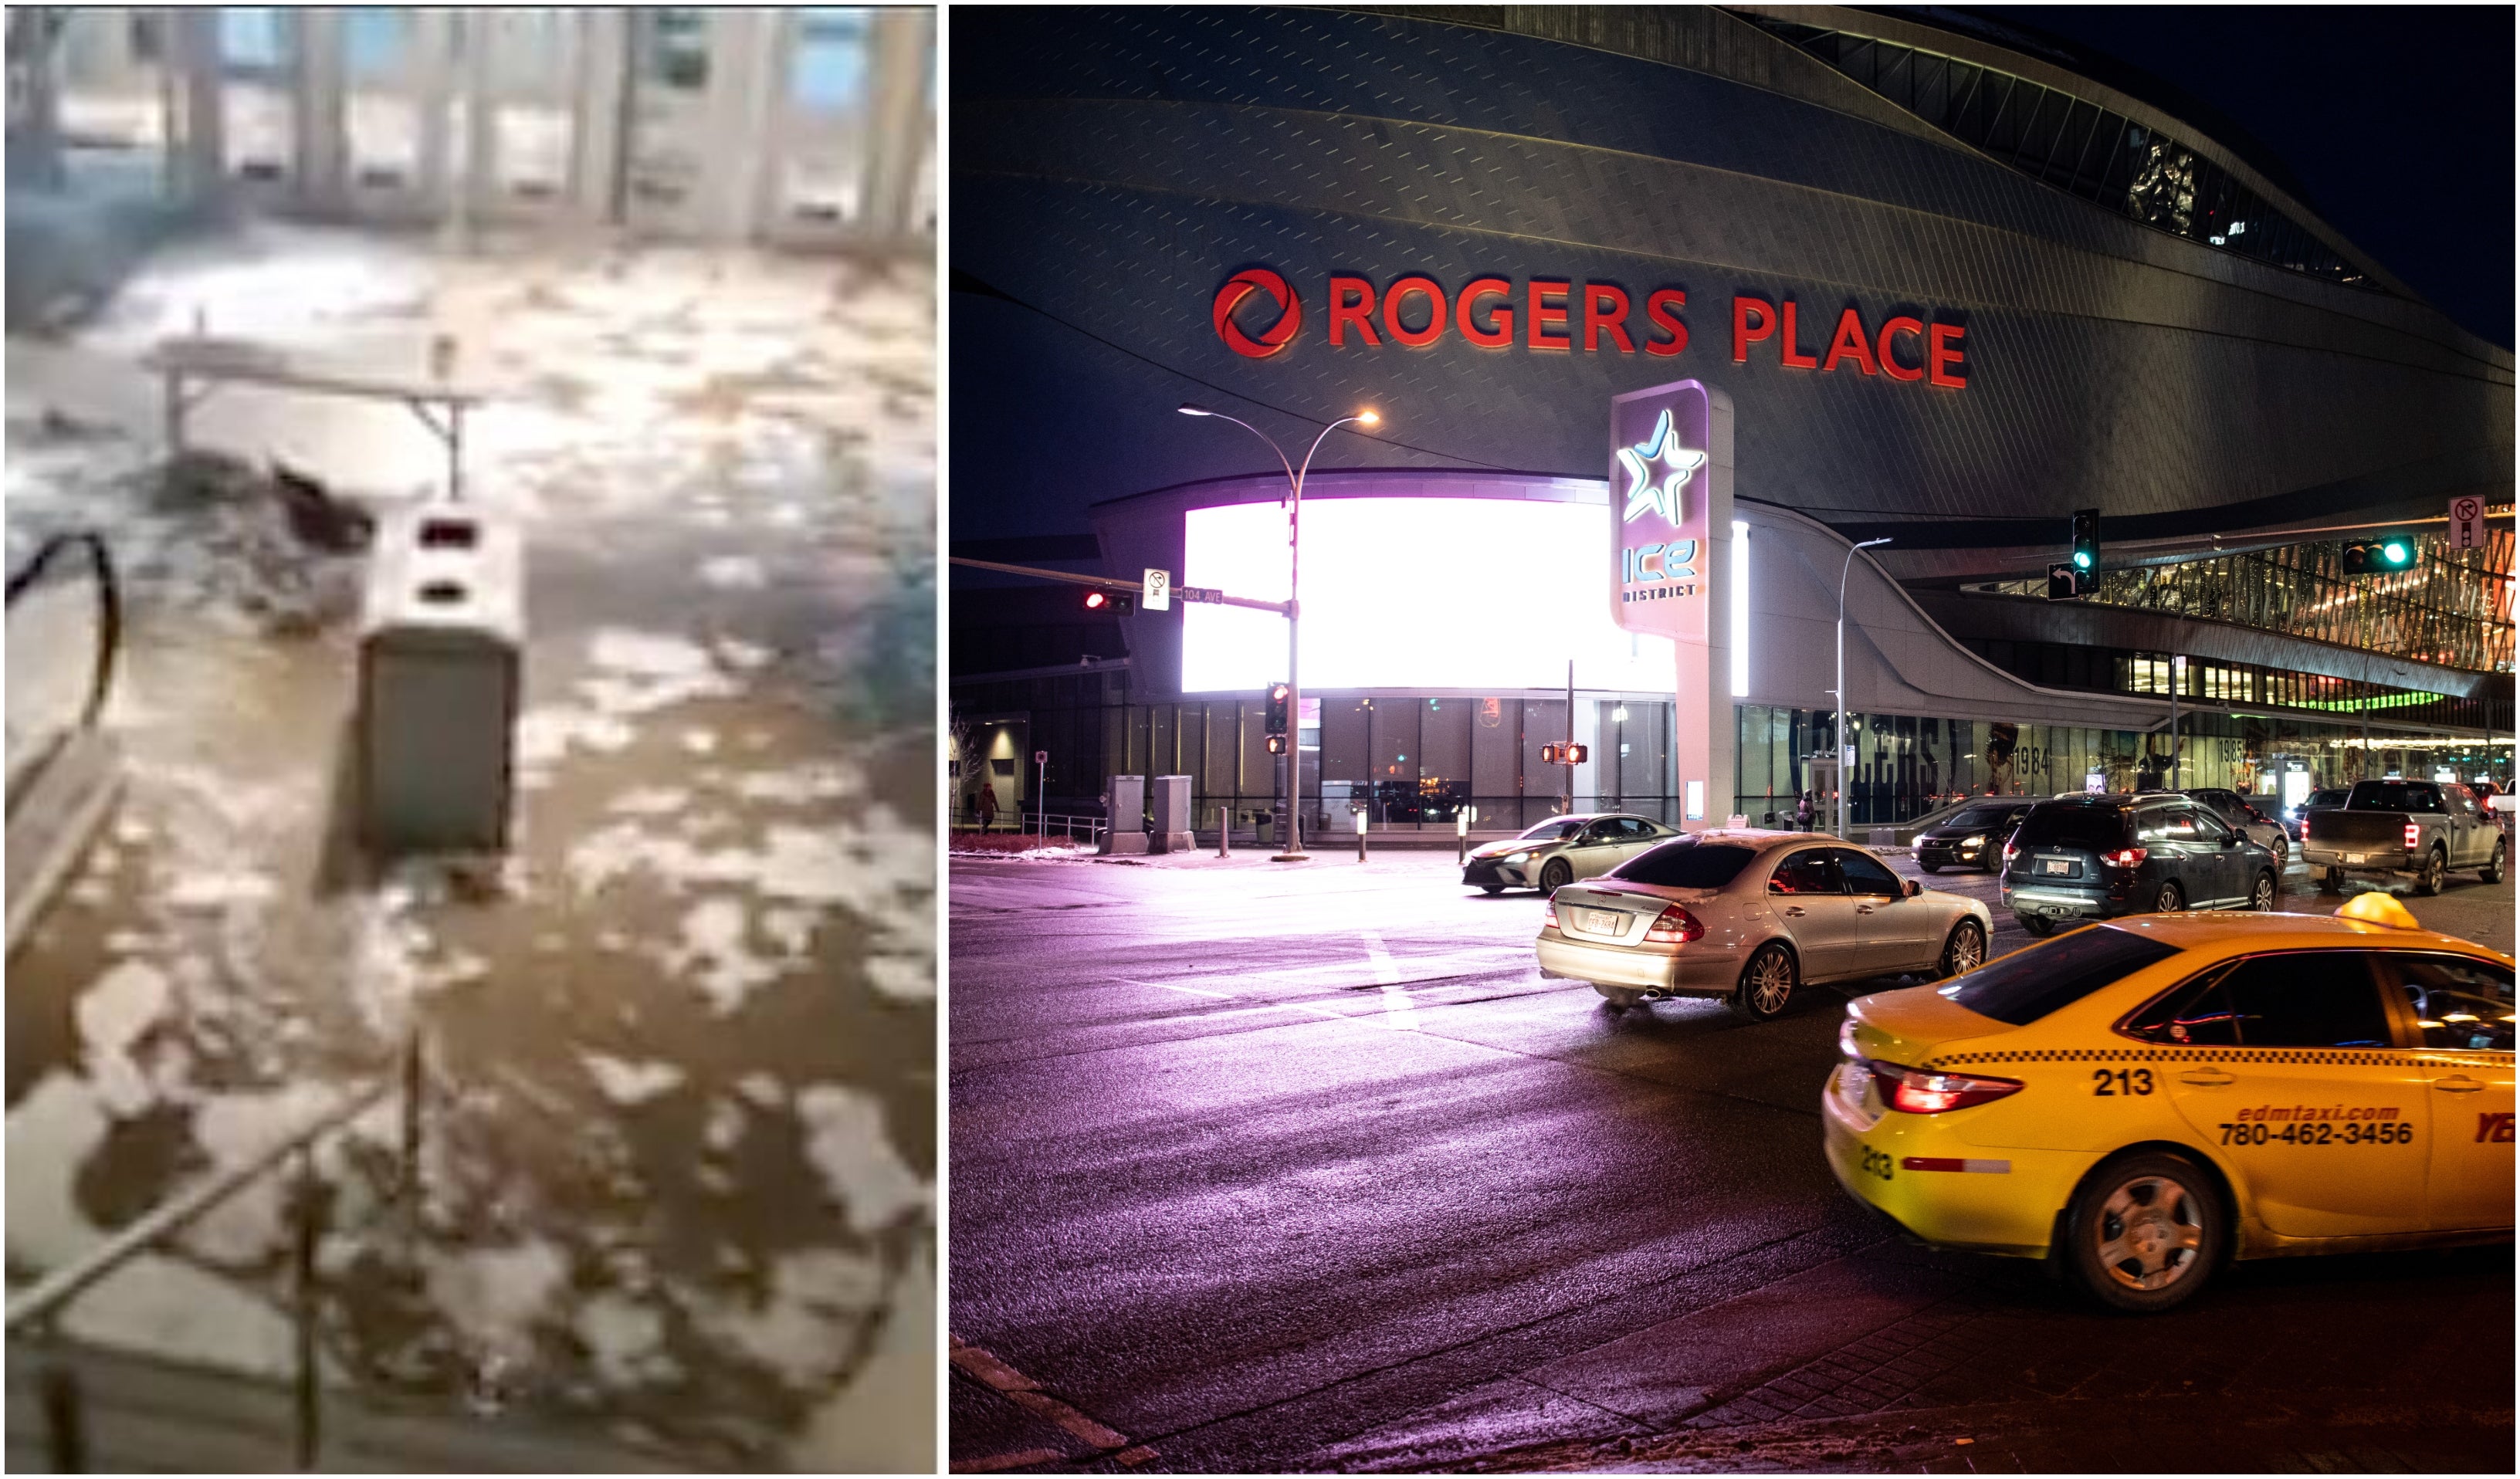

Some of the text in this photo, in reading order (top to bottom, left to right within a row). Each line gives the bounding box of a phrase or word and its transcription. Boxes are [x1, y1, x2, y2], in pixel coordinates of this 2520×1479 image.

[1329, 277, 1968, 389] ROGERS PLACE
[1184, 589, 1221, 602] 104 AVE
[1622, 584, 1695, 603] DISTRICT
[2015, 746, 2048, 776] 1984
[2220, 739, 2242, 763] 1985
[2093, 1068, 2154, 1097] 213
[2237, 1104, 2400, 1121] edmtaxi.com
[2218, 1122, 2413, 1146] 780-462-3456
[1861, 1144, 1894, 1180] 213
